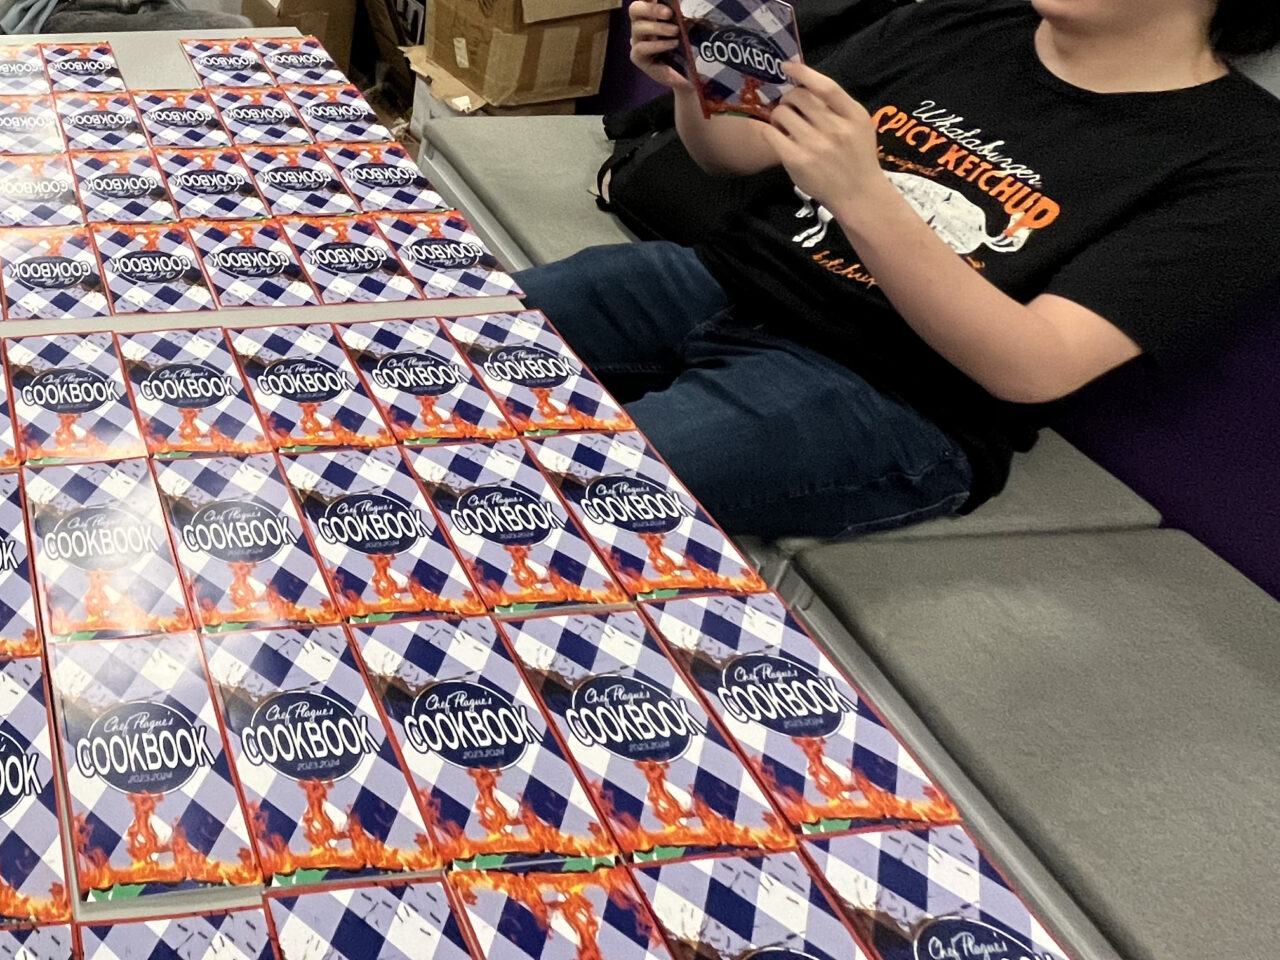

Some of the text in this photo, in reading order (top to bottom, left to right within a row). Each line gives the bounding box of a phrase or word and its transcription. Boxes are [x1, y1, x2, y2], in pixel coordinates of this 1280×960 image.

[67, 114, 132, 124] COOKBOOK
[147, 111, 211, 120] COOKBOOK
[225, 109, 289, 118] COOKBOOK
[302, 106, 367, 116] COOKBOOK
[912, 100, 1042, 186] Whataburger
[172, 174, 244, 186] COOKBOOK
[258, 170, 333, 183] COOKBOOK
[343, 168, 416, 180] COOKBOOK
[872, 105, 1062, 237] SPICY KETCHUP
[83, 177, 157, 191] COOKBOOK
[207, 252, 289, 267] COOKBOOK
[306, 246, 386, 265] COOKBOOK
[399, 243, 482, 260] COOKBOOK
[9, 261, 90, 278] COOKBOOK
[109, 256, 191, 273] COOKBOOK
[372, 365, 470, 388] COOKBOOK
[484, 357, 582, 381] COOKBOOK
[23, 381, 120, 406] COOKBOOK
[141, 376, 238, 400] COOKBOOK
[257, 371, 356, 395] COOKBOOK
[451, 502, 566, 535] COOKBOOK
[583, 492, 692, 524] COOKBOOK
[183, 517, 298, 551] COOKBOOK
[318, 510, 433, 544] COOKBOOK
[45, 524, 159, 560] COOKBOOK
[734, 666, 760, 687] Chef
[425, 694, 450, 715] Chef
[585, 687, 610, 709] Chef
[719, 678, 860, 721] COOKBOOK
[103, 715, 130, 738] Chef
[265, 704, 291, 726] Chef
[567, 699, 706, 746] COOKBOOK
[242, 716, 381, 764] COOKBOOK
[405, 705, 544, 752] COOKBOOK
[77, 726, 216, 777] COOKBOOK
